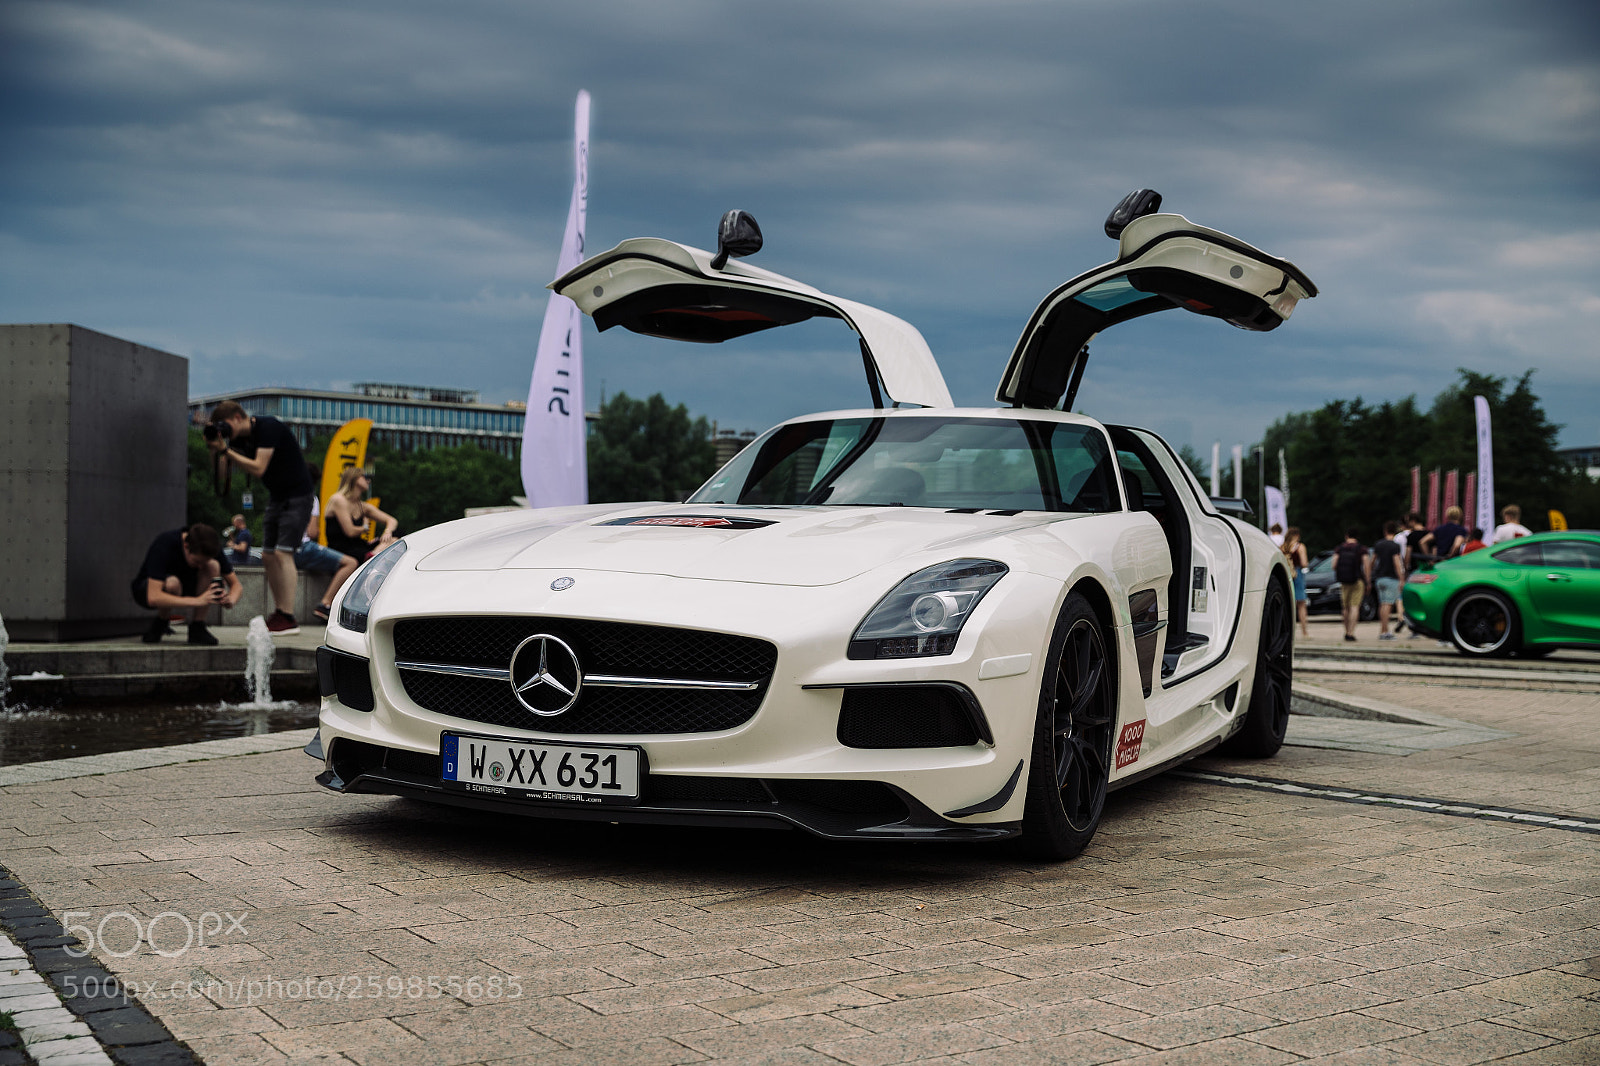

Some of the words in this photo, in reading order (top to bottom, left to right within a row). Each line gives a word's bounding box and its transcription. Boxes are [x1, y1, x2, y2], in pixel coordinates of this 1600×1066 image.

[1124, 724, 1142, 743] 1000
[447, 762, 454, 773] D
[470, 743, 486, 779] W
[507, 747, 547, 785] XX
[557, 752, 621, 790] 631
[472, 784, 507, 795] SCHMERSAL
